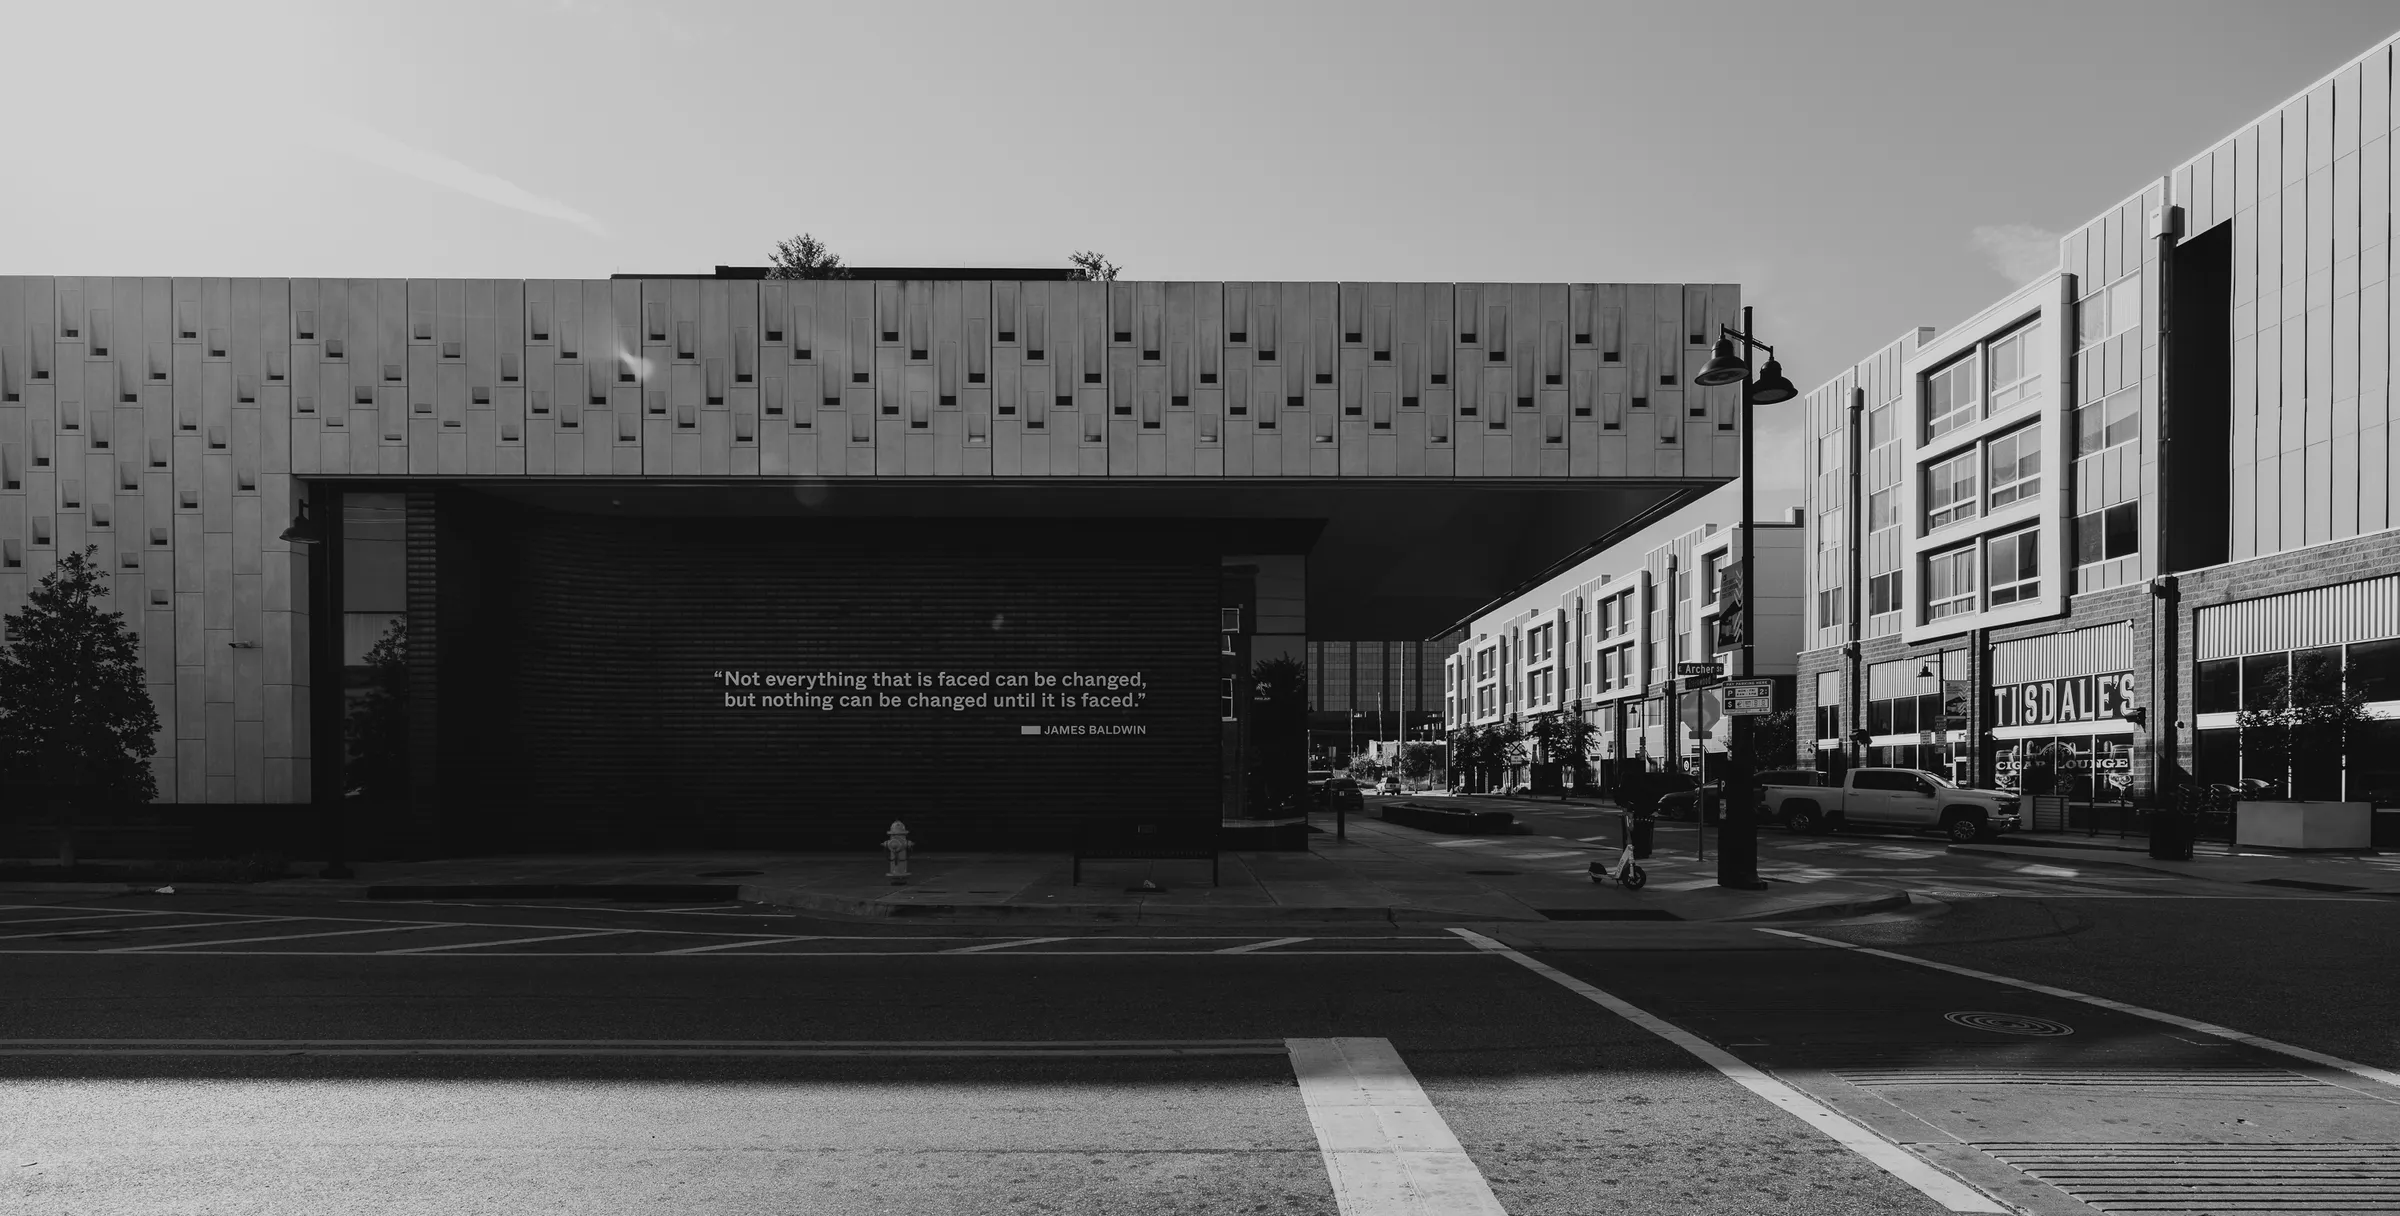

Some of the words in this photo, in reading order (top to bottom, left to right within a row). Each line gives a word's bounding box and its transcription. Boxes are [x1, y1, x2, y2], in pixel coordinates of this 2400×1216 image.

[1685, 664, 1714, 674] Archer
[714, 671, 760, 687] “Not
[766, 671, 867, 691] everything
[872, 671, 912, 687] that
[918, 671, 933, 687] is
[938, 671, 990, 687] faced
[995, 674, 1029, 687] can
[1034, 671, 1057, 687] be
[1062, 671, 1147, 691] changed,
[724, 691, 757, 708] but
[763, 691, 835, 711] nothing
[840, 695, 873, 708] can
[880, 691, 902, 708] be
[907, 692, 987, 711] changed
[993, 692, 1036, 708] until
[1042, 692, 1055, 708] it
[1061, 692, 1077, 708] is
[1081, 692, 1147, 708] faced.”
[1995, 673, 2135, 727] TISDALE'S
[1044, 725, 1086, 735] JAMES
[1089, 725, 1146, 735] BALDWIN
[2057, 758, 2129, 770] LOUNGE
